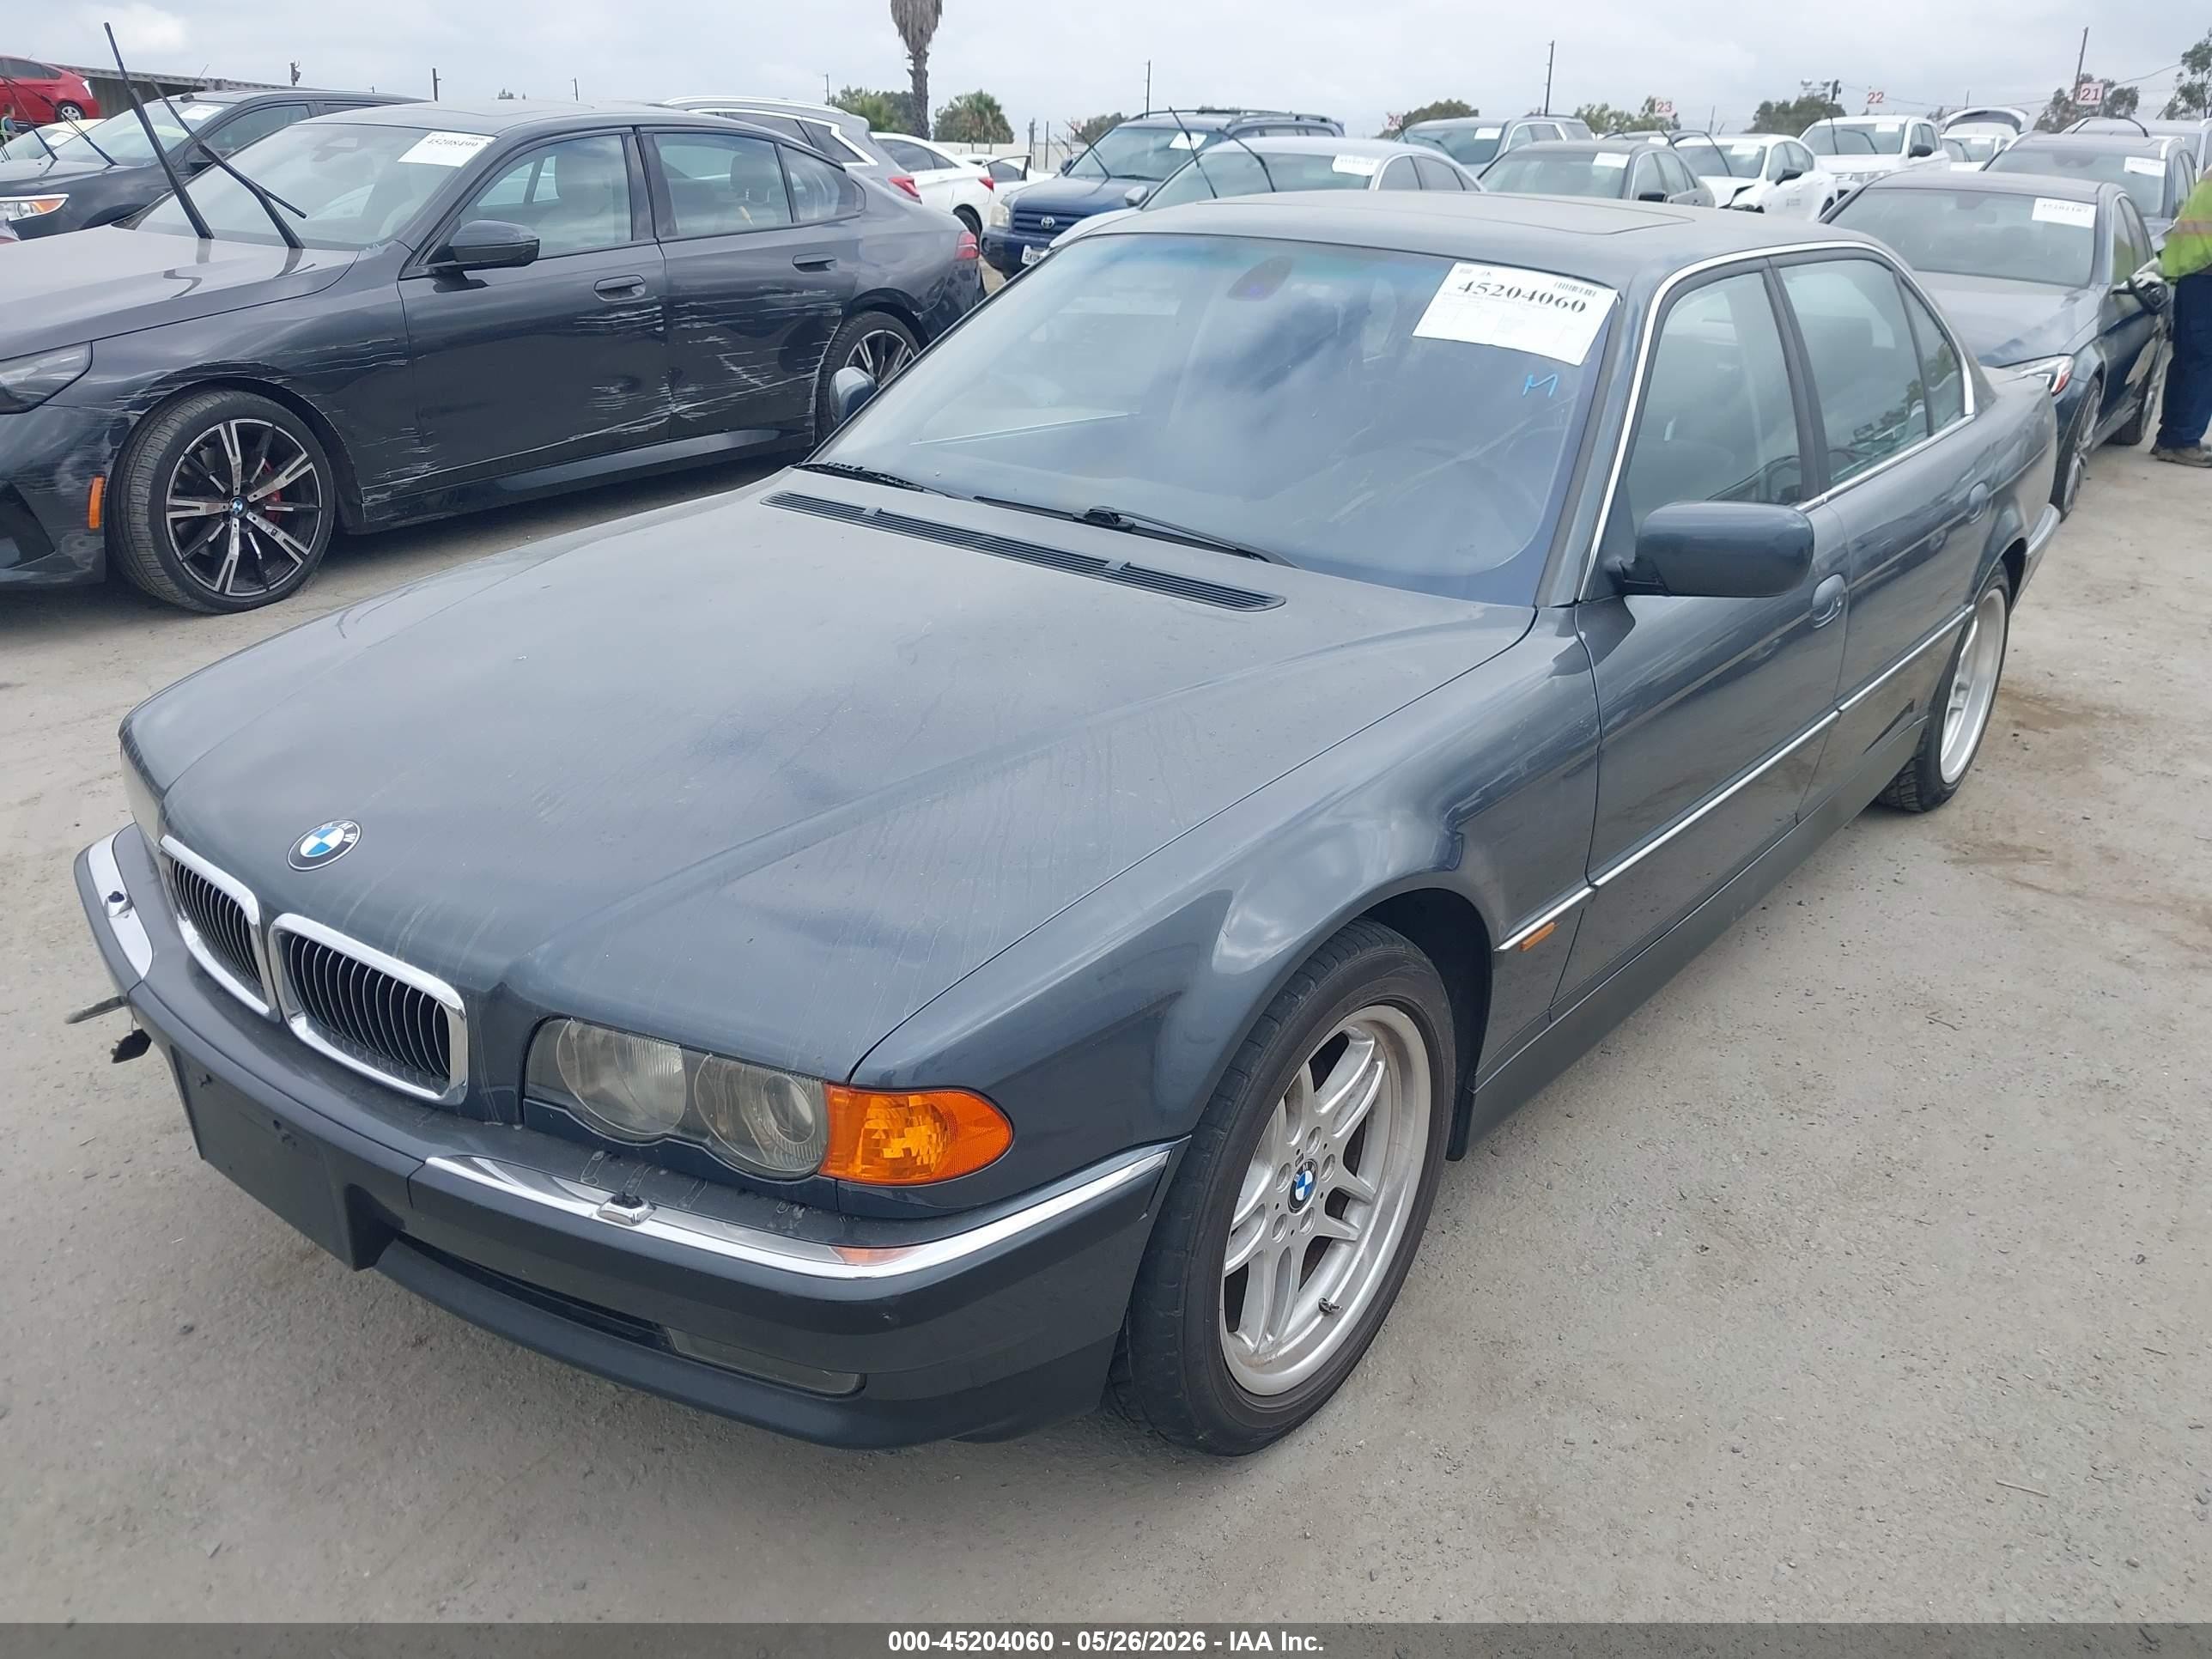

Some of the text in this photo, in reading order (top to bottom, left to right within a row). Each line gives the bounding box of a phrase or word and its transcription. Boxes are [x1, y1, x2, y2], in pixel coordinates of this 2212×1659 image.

[1868, 91, 1884, 104] 22
[2081, 88, 2100, 101] 21
[1656, 100, 1673, 112] 23
[1458, 281, 1587, 313] 45204060
[1522, 373, 1559, 398] M
[1293, 1162, 1316, 1182] BMW
